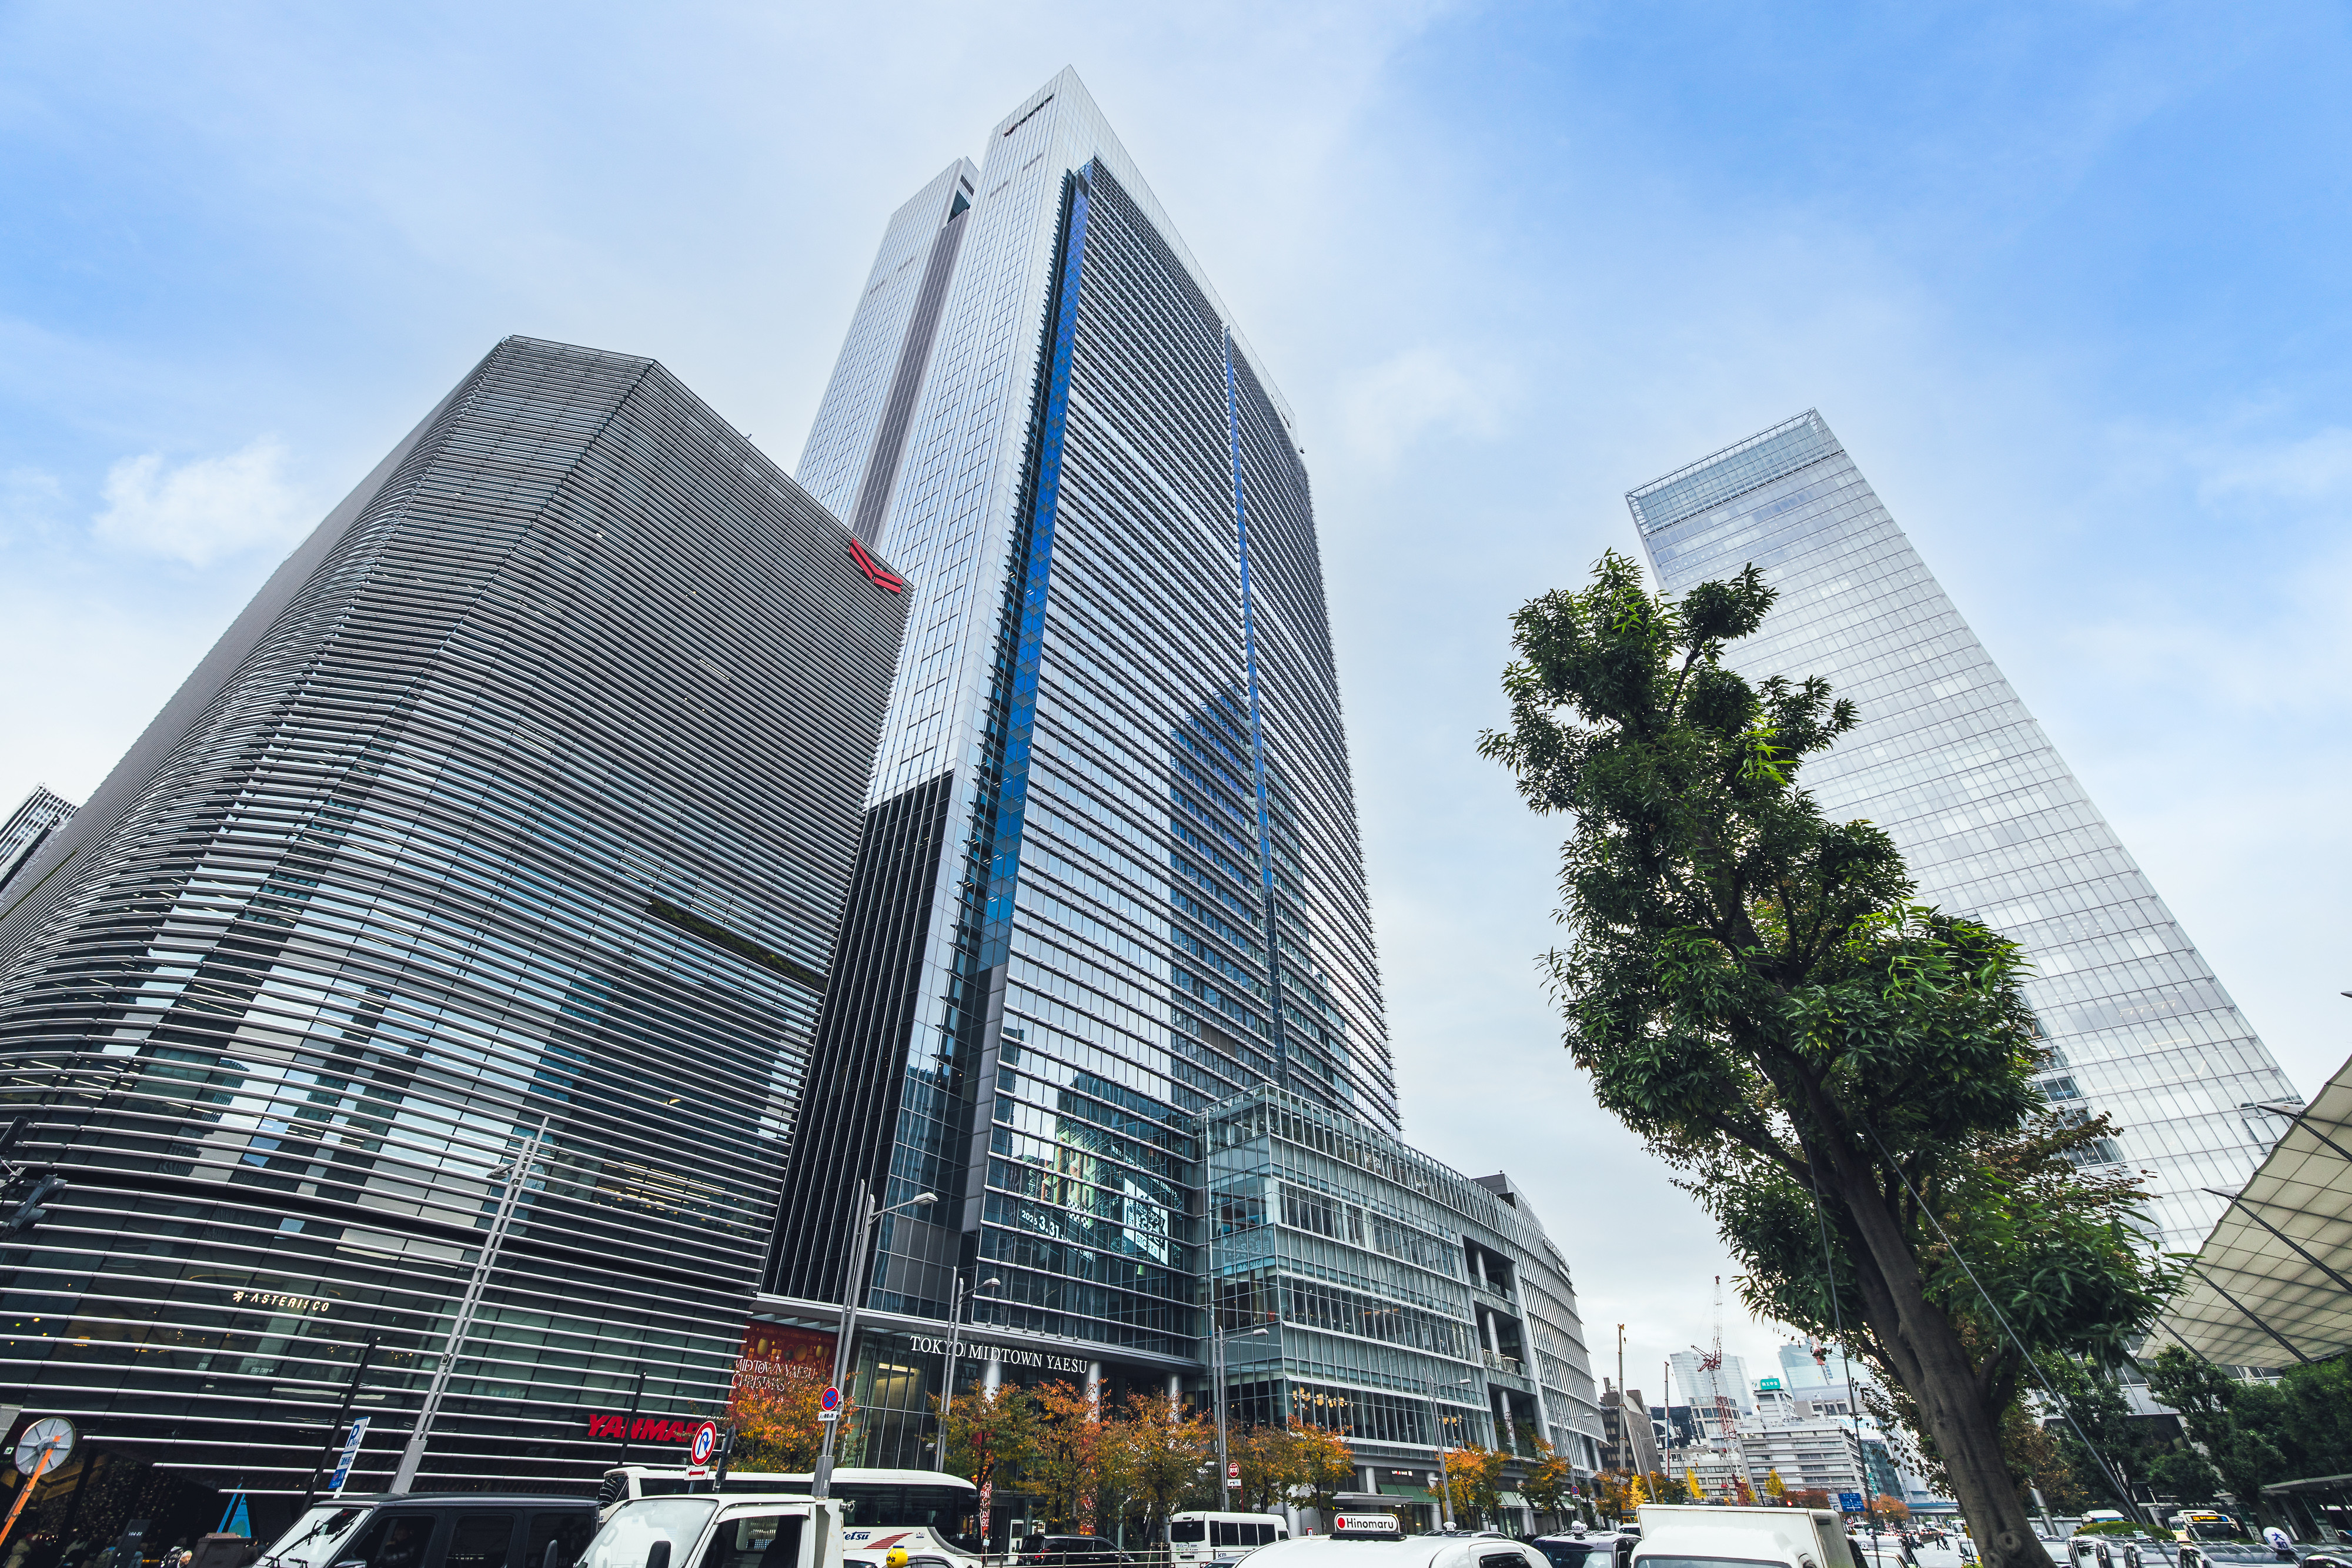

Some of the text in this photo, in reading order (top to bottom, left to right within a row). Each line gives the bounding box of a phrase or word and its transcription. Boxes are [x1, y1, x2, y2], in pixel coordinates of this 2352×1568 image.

[1021, 1210, 1038, 1225] 2026
[1039, 1216, 1060, 1239] 3.31
[250, 1293, 329, 1312] ASTERISCO
[910, 1336, 1087, 1374] TOKYO MIDTOWN YAESU
[346, 1424, 360, 1447] P
[1347, 1518, 1394, 1529] Hinomaru
[843, 1531, 871, 1540] etsu
[2271, 1532, 2288, 1549] 大和
